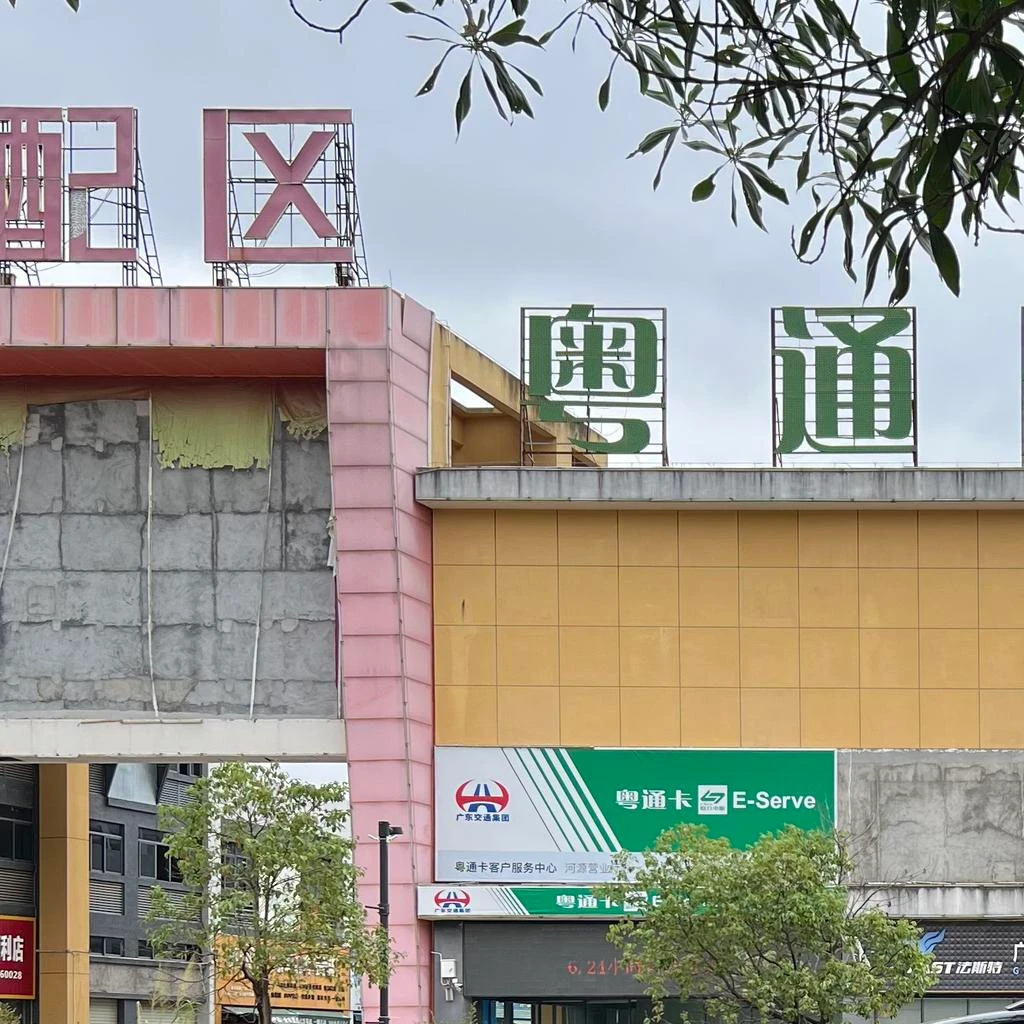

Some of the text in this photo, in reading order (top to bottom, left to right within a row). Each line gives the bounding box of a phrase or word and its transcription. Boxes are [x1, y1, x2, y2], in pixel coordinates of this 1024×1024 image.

[615, 789, 693, 810] 粤通卡
[732, 791, 817, 809] E-Serve
[455, 813, 511, 822] 广东交通集团
[454, 861, 557, 874] 粤通卡客户服务中心
[955, 961, 1003, 974] 法斯特
